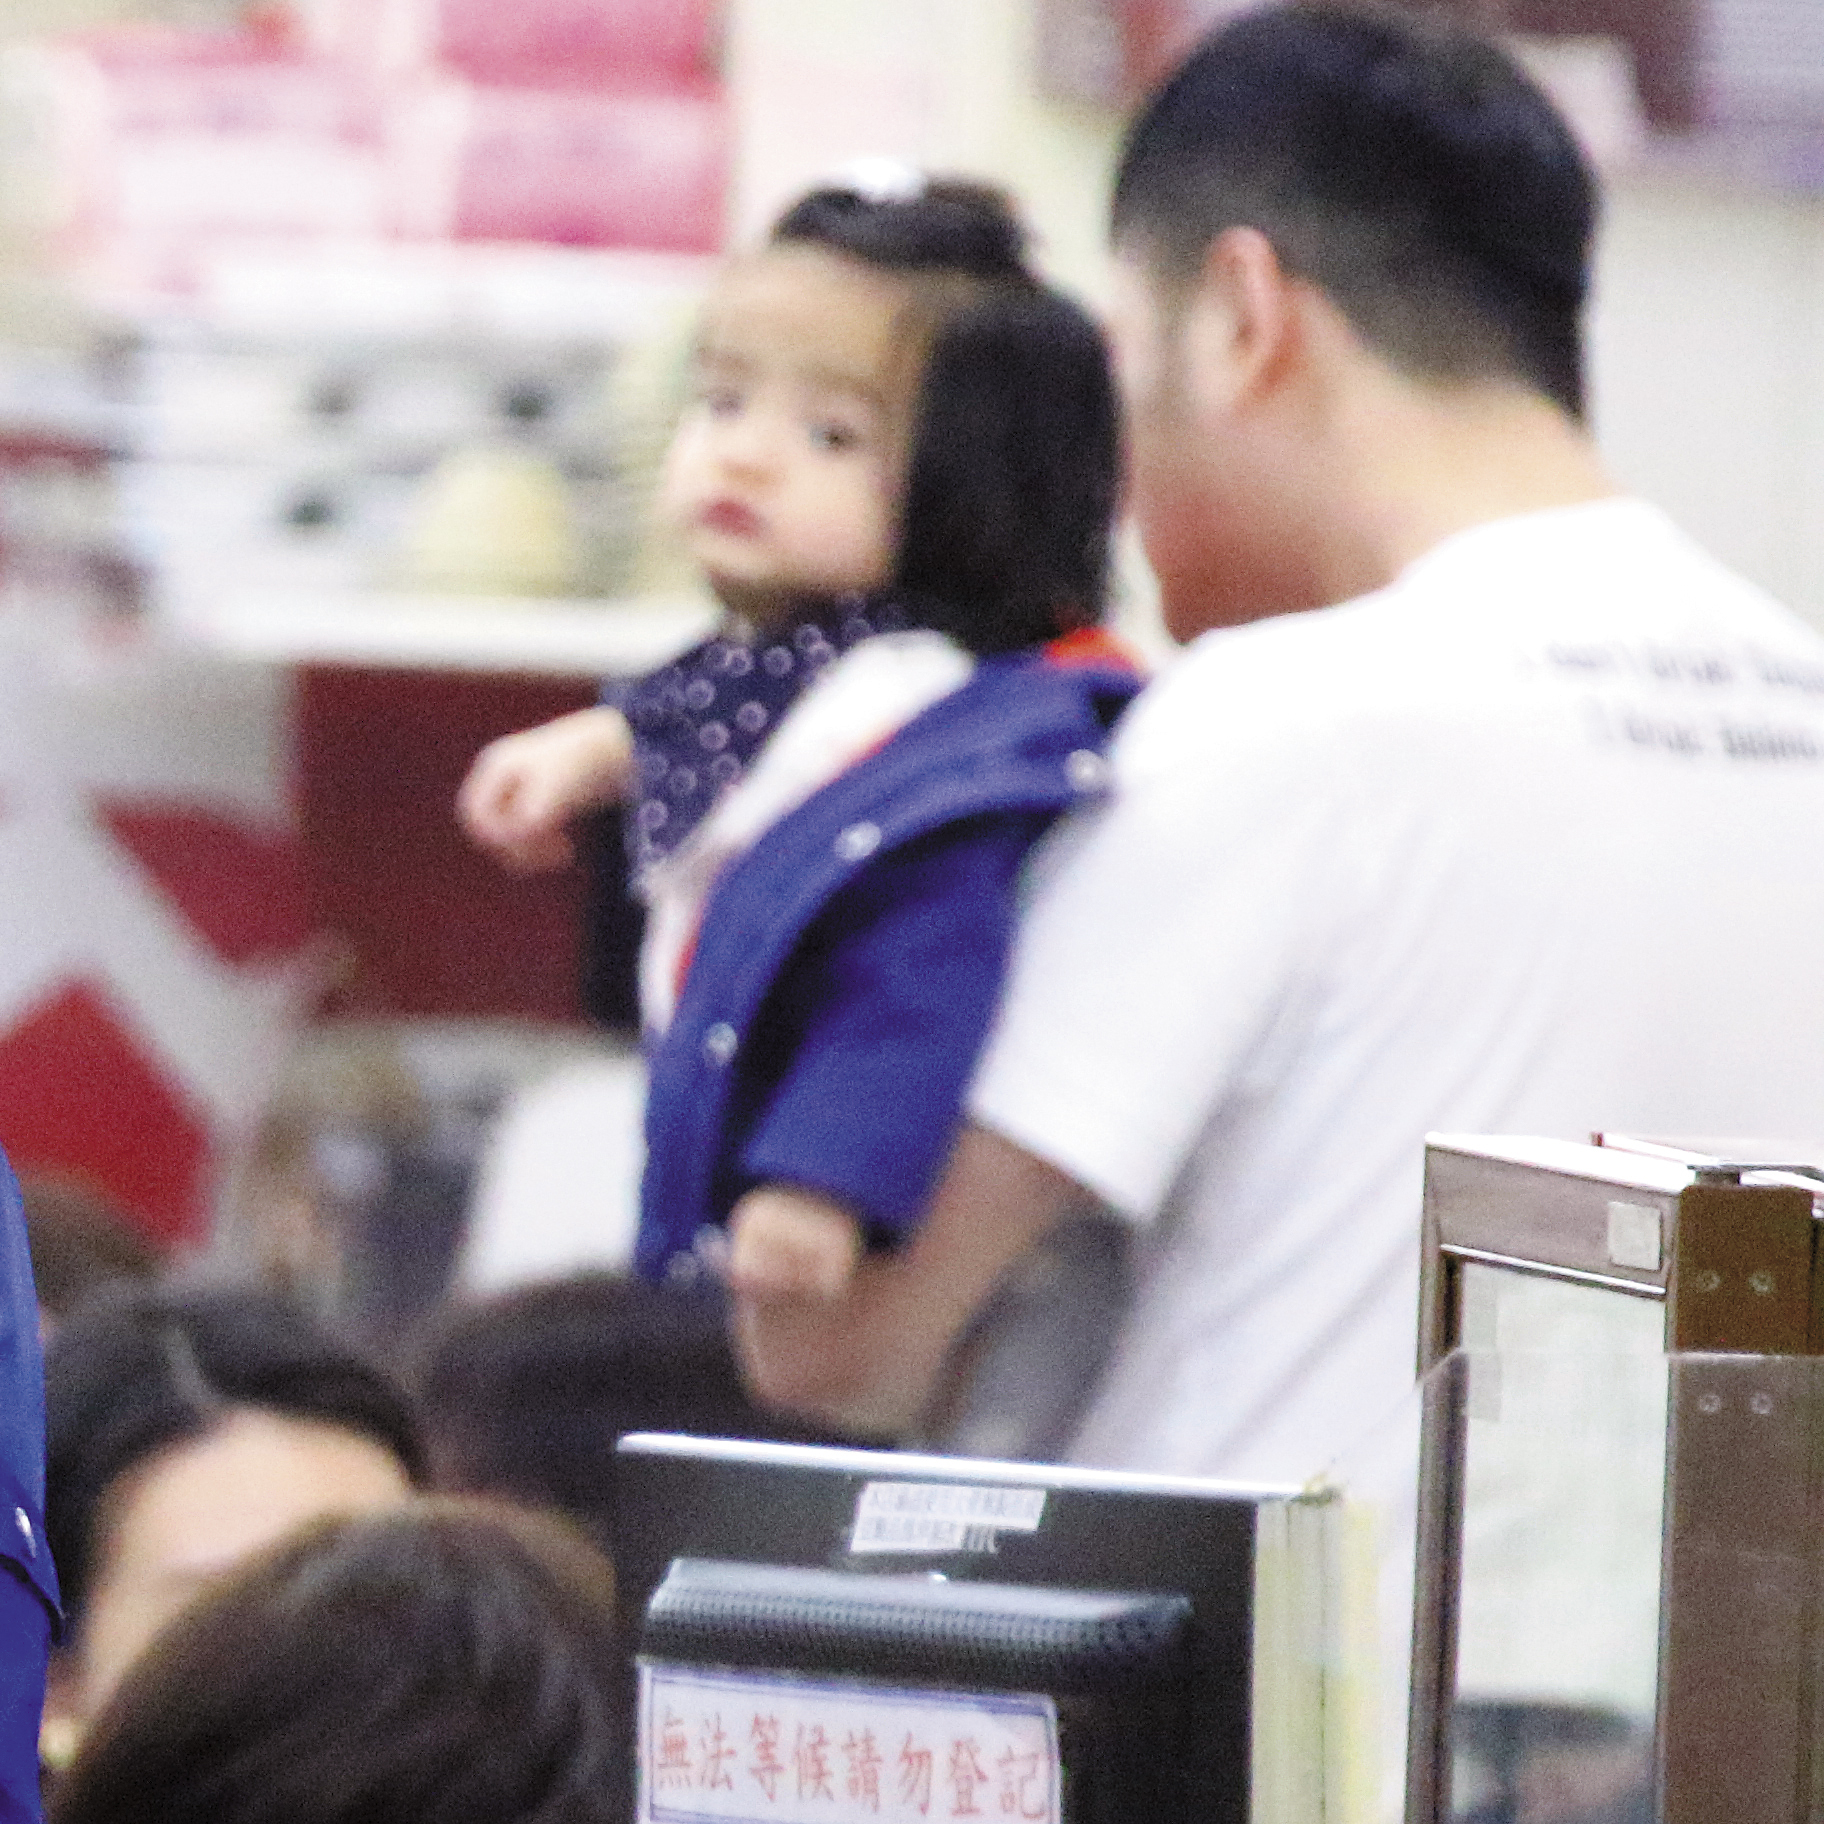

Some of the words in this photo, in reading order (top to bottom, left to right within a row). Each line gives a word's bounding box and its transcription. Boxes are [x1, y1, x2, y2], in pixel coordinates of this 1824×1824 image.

[654, 1710, 1050, 1822] 無法等候請勿登記
